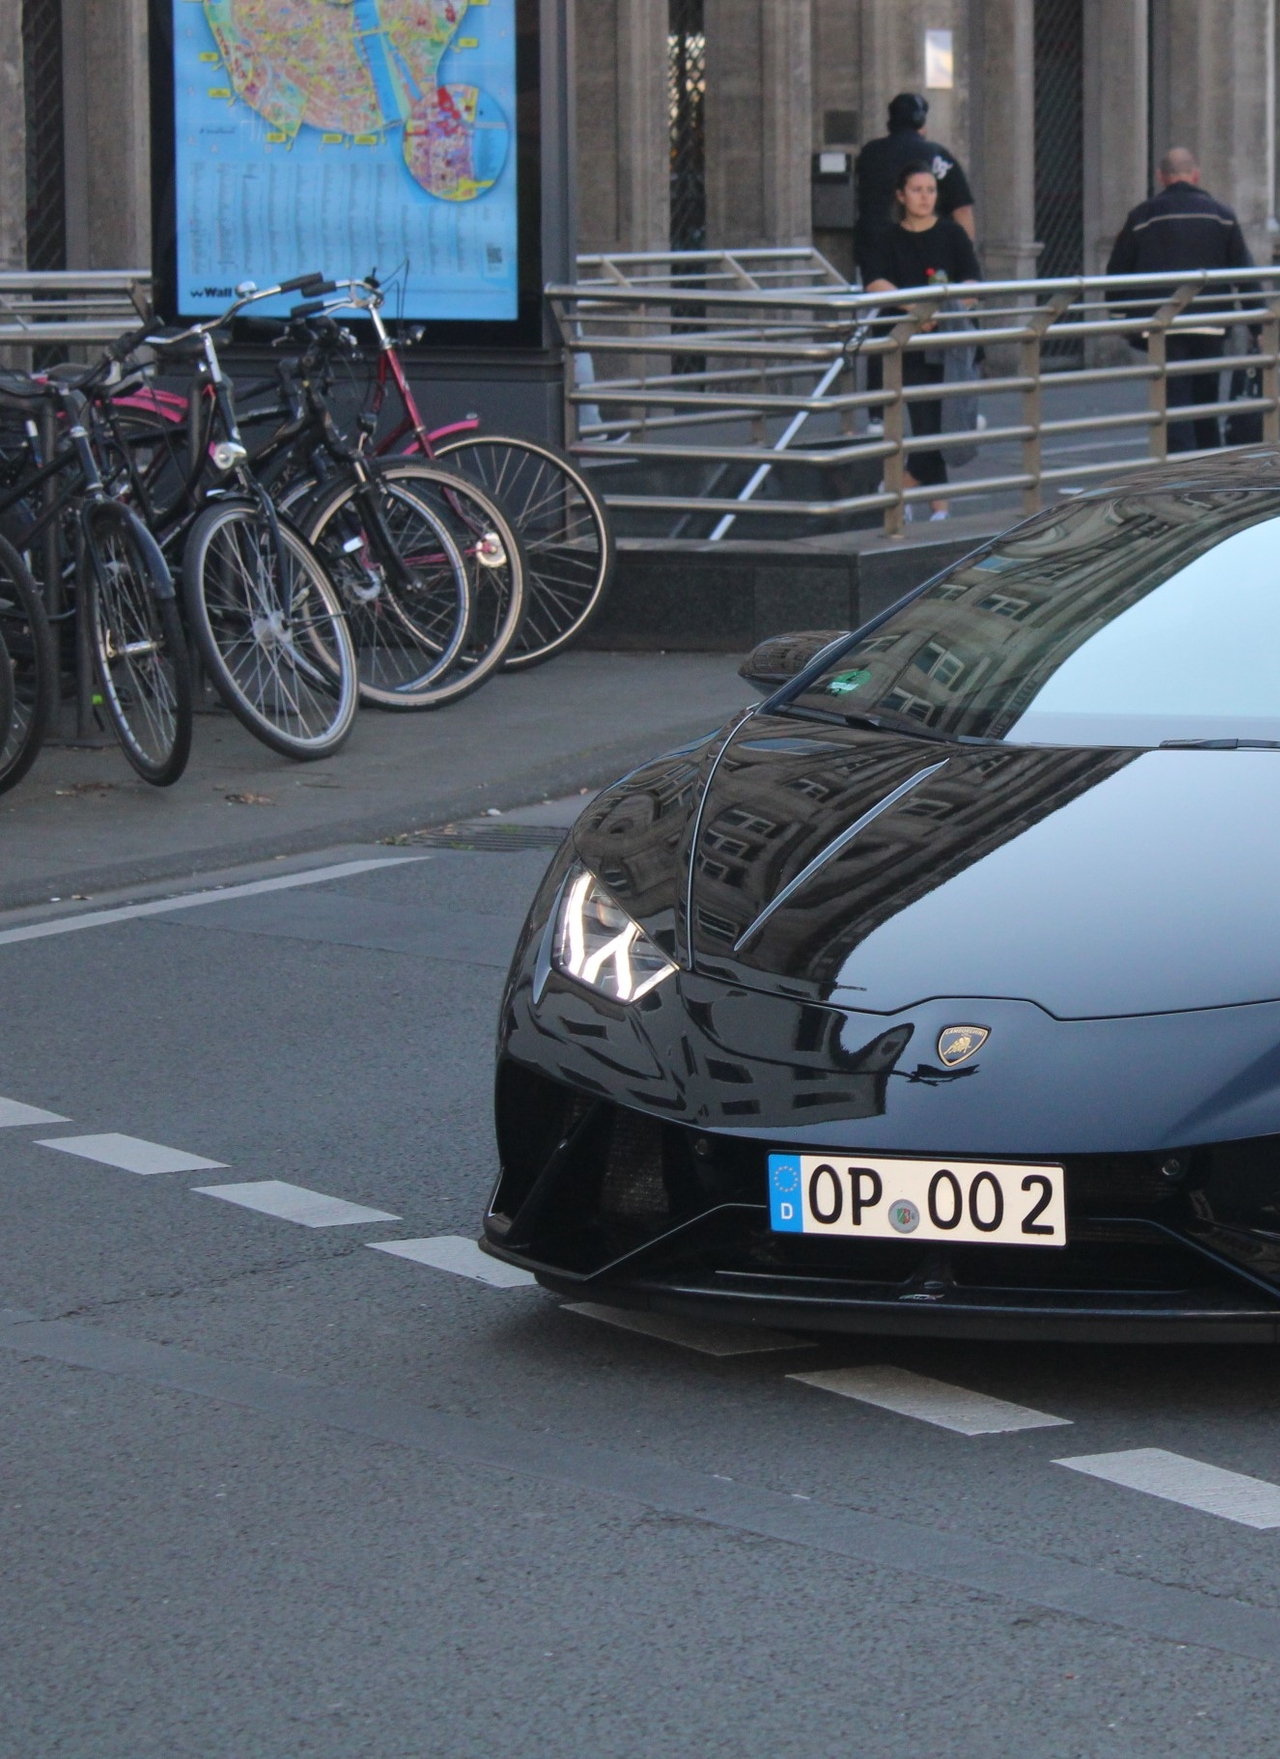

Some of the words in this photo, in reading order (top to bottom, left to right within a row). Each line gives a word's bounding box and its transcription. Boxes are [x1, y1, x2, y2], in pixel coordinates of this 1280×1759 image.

[204, 286, 233, 298] Wall
[808, 1163, 883, 1226] OP
[780, 1202, 794, 1220] D
